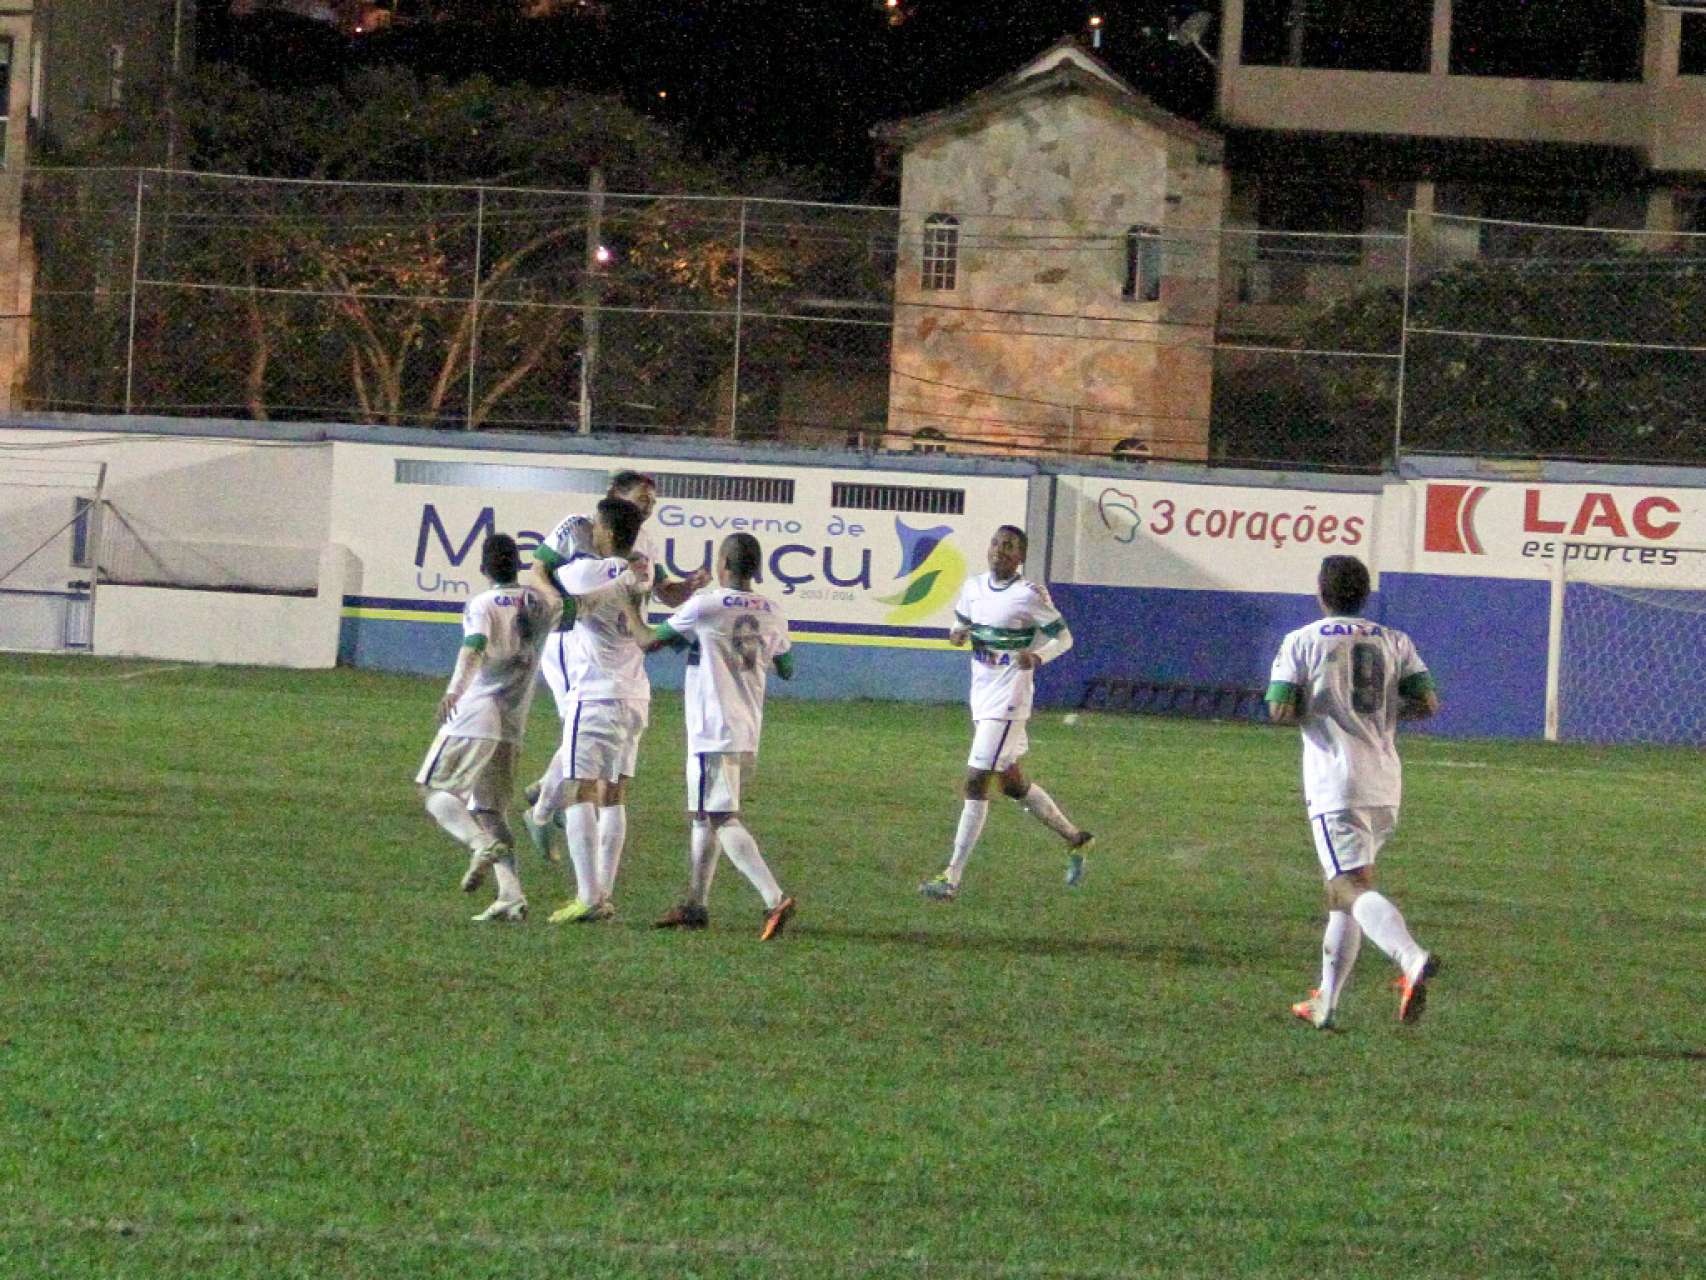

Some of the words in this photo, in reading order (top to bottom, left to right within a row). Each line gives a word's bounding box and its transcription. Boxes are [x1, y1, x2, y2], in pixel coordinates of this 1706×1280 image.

[658, 504, 802, 534] Governo
[827, 514, 866, 537] de
[1150, 499, 1176, 536] 3
[1185, 505, 1365, 549] corações
[1523, 488, 1682, 541] LAC
[1521, 540, 1678, 567] esportes
[416, 572, 470, 594] Um
[1319, 623, 1384, 636] CAIXA
